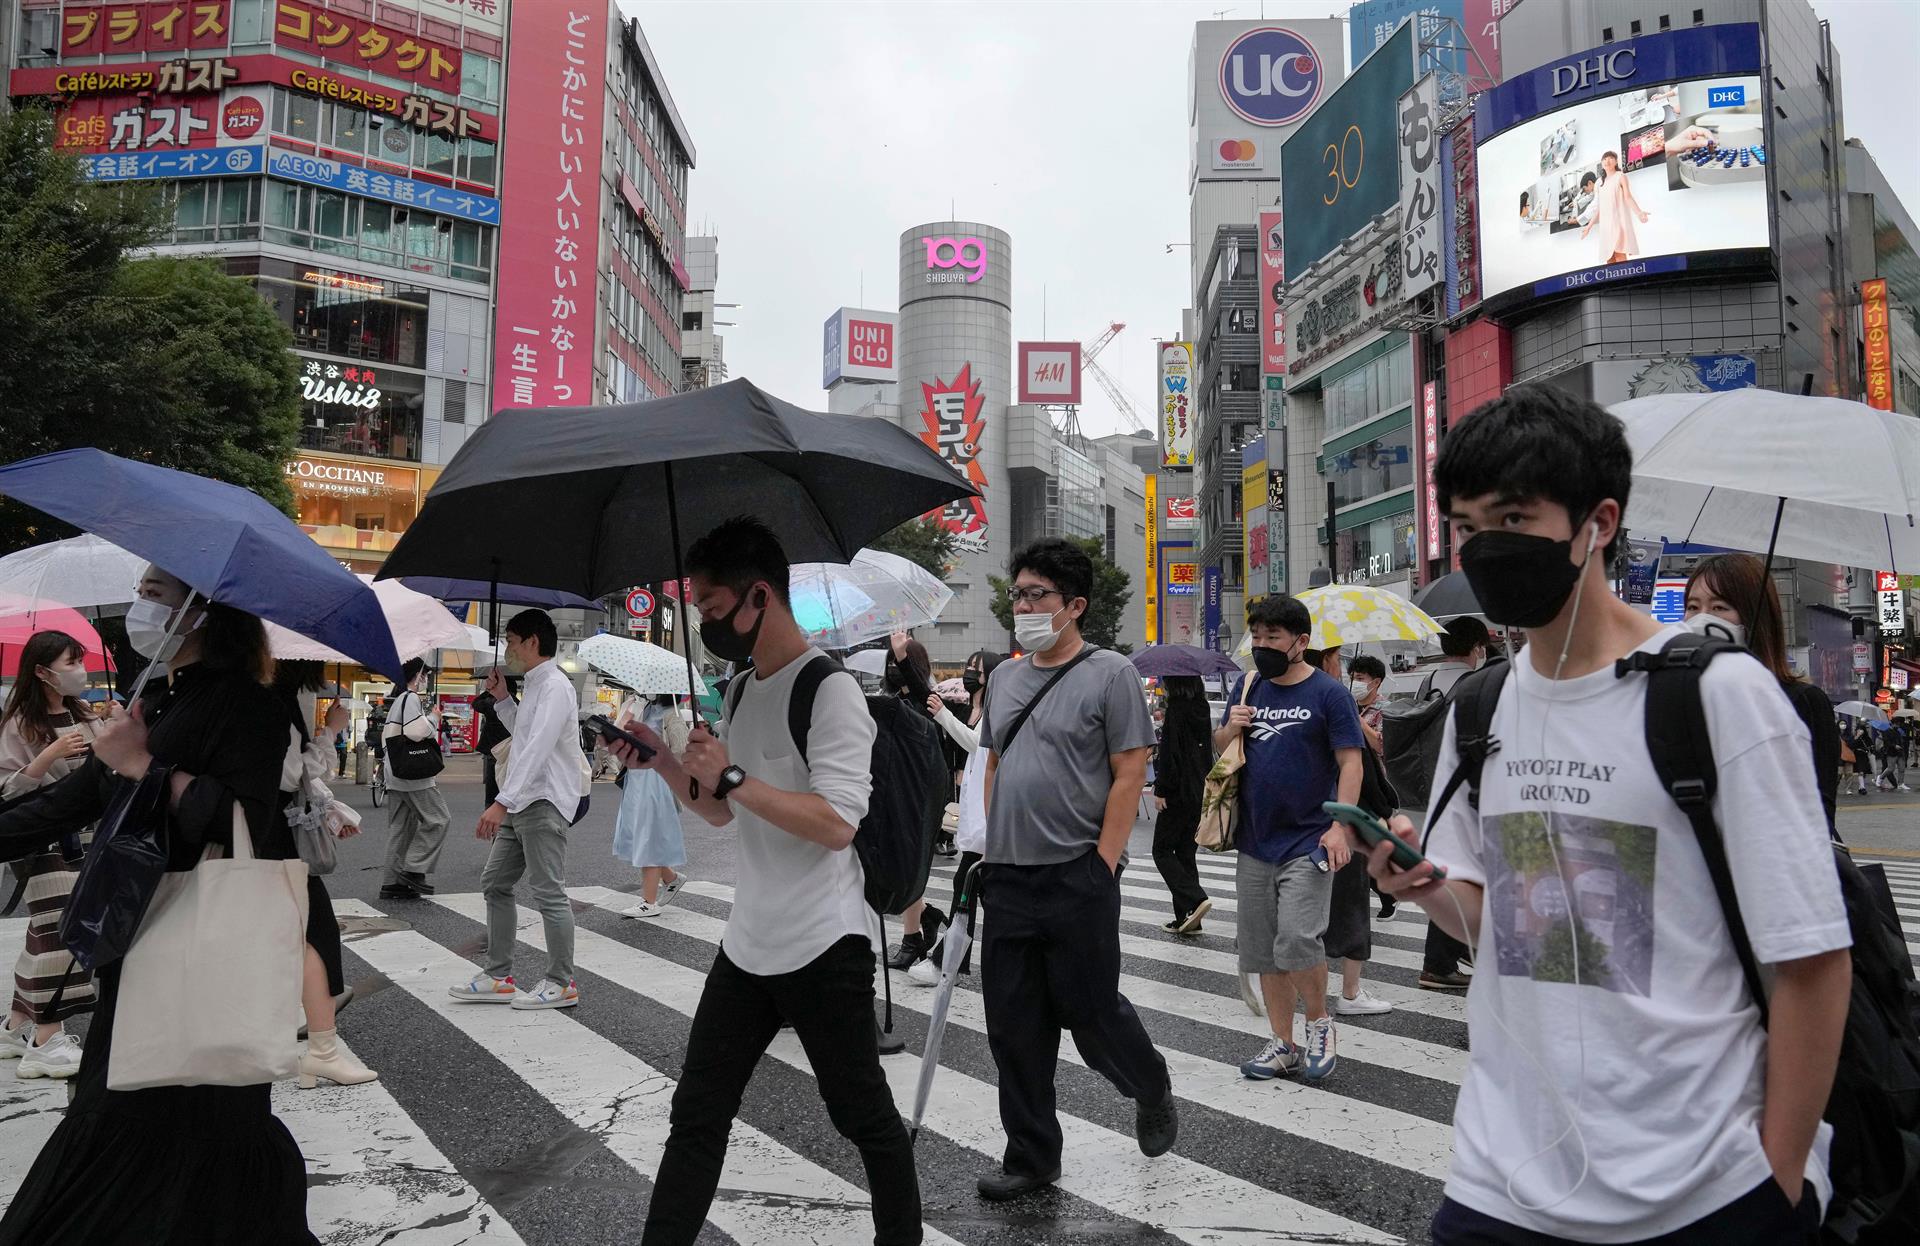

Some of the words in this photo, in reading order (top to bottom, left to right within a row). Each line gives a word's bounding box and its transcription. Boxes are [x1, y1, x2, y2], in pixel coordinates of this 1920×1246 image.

[66, 4, 224, 46] プライス
[277, 4, 455, 80] コンタクト
[158, 59, 238, 93] ガスト
[1232, 52, 1312, 97] UC
[1551, 47, 1636, 98] DHC
[1712, 91, 1741, 102] DHC
[63, 115, 106, 135] Café
[109, 107, 209, 151] ガスト
[228, 115, 260, 128] ガスト
[401, 96, 481, 138] ガスト
[228, 152, 250, 168] 6F
[277, 154, 333, 182] AEON
[346, 169, 496, 217] 英会話イーオン
[1402, 90, 1438, 282] もんじゃ
[547, 10, 590, 408] どこかにいい人いないかなーっ
[922, 237, 987, 284] 109
[926, 273, 965, 283] SHIBUYA
[1565, 272, 1593, 287] DHC
[1594, 263, 1646, 282] Channel
[853, 326, 885, 344] UNI
[1867, 284, 1886, 400] クスリのことなら
[853, 344, 888, 363] QLO
[1034, 361, 1066, 384] H&M
[300, 376, 381, 409] Ushi8
[286, 461, 385, 485] L'OCCITANE
[303, 481, 315, 489] EN
[320, 482, 368, 494] PROVENCE
[1881, 574, 1898, 590] 肉
[1883, 592, 1900, 623] 牛繁
[1251, 706, 1311, 720] rlando
[1567, 761, 1617, 782] PLAY
